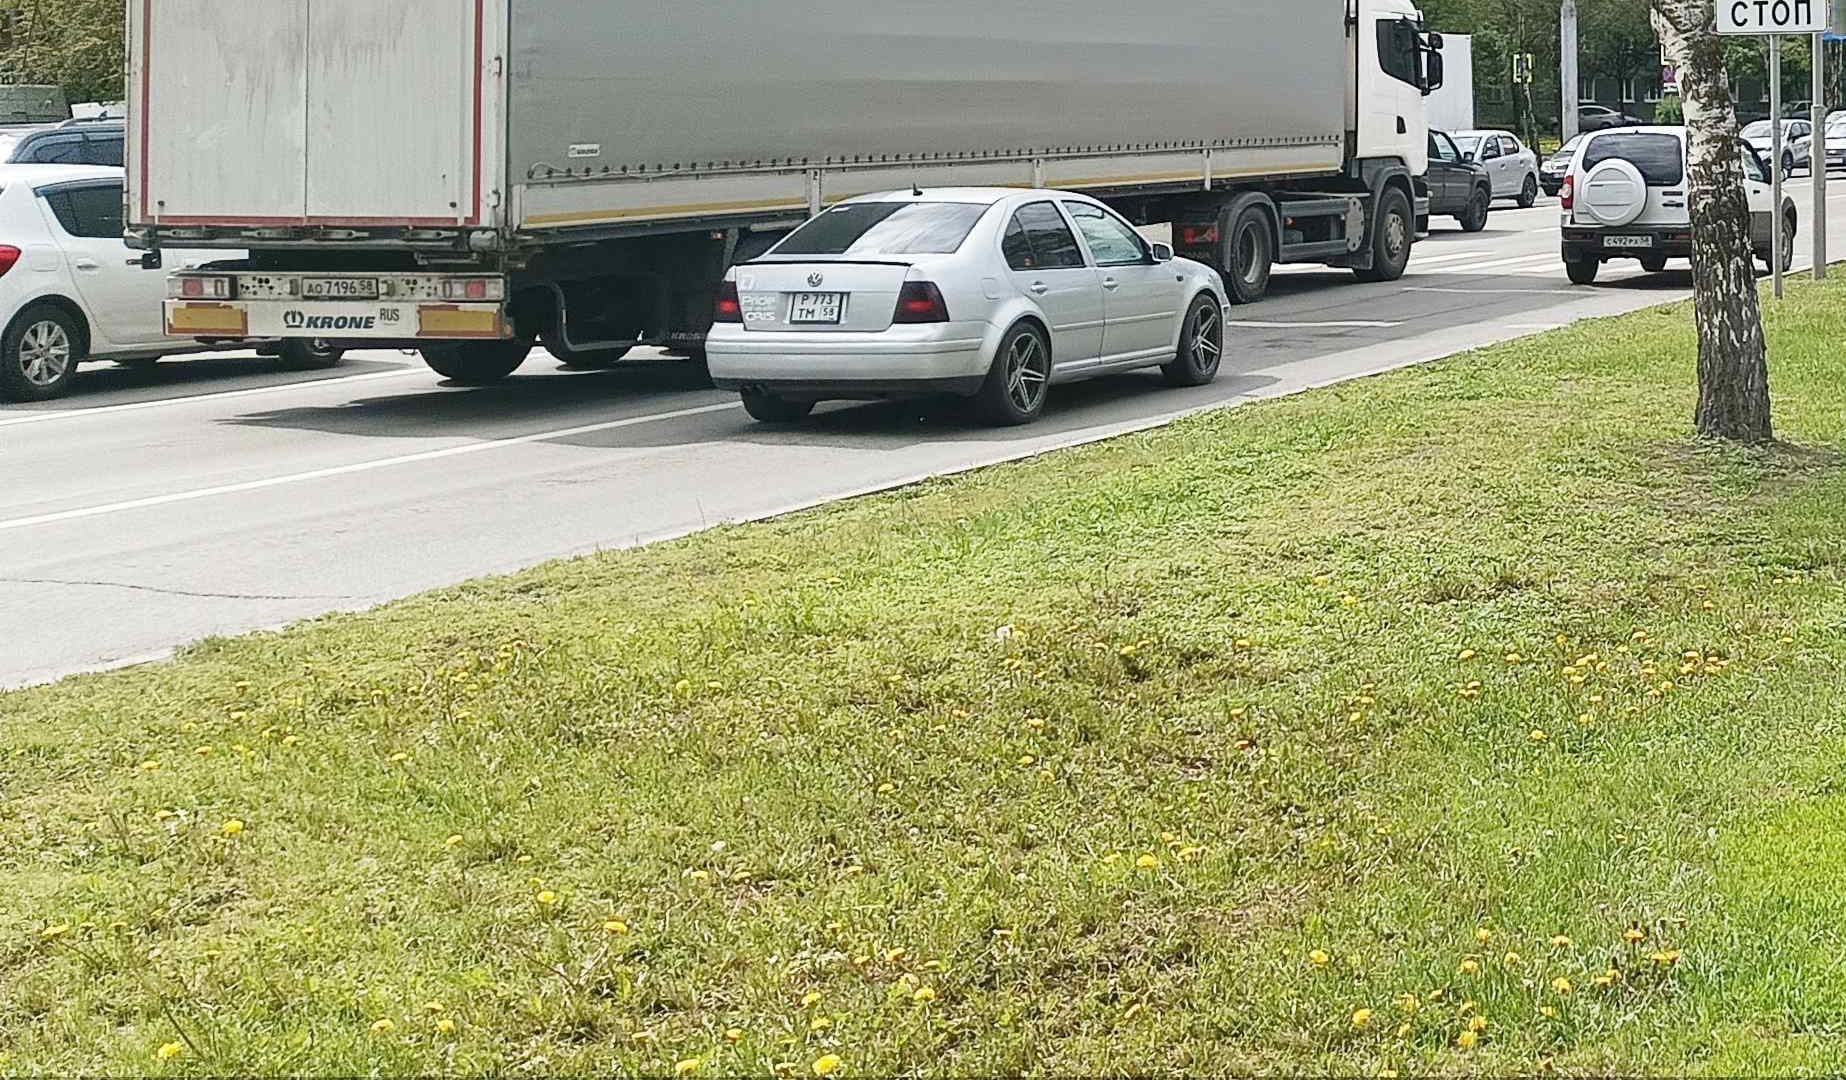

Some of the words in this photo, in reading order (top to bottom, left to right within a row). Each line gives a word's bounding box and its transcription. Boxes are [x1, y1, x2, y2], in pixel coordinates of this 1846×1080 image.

[1730, 0, 1812, 26] СТОП
[813, 294, 833, 305] 773
[379, 307, 400, 322] RUS
[305, 315, 376, 329] KRONE
